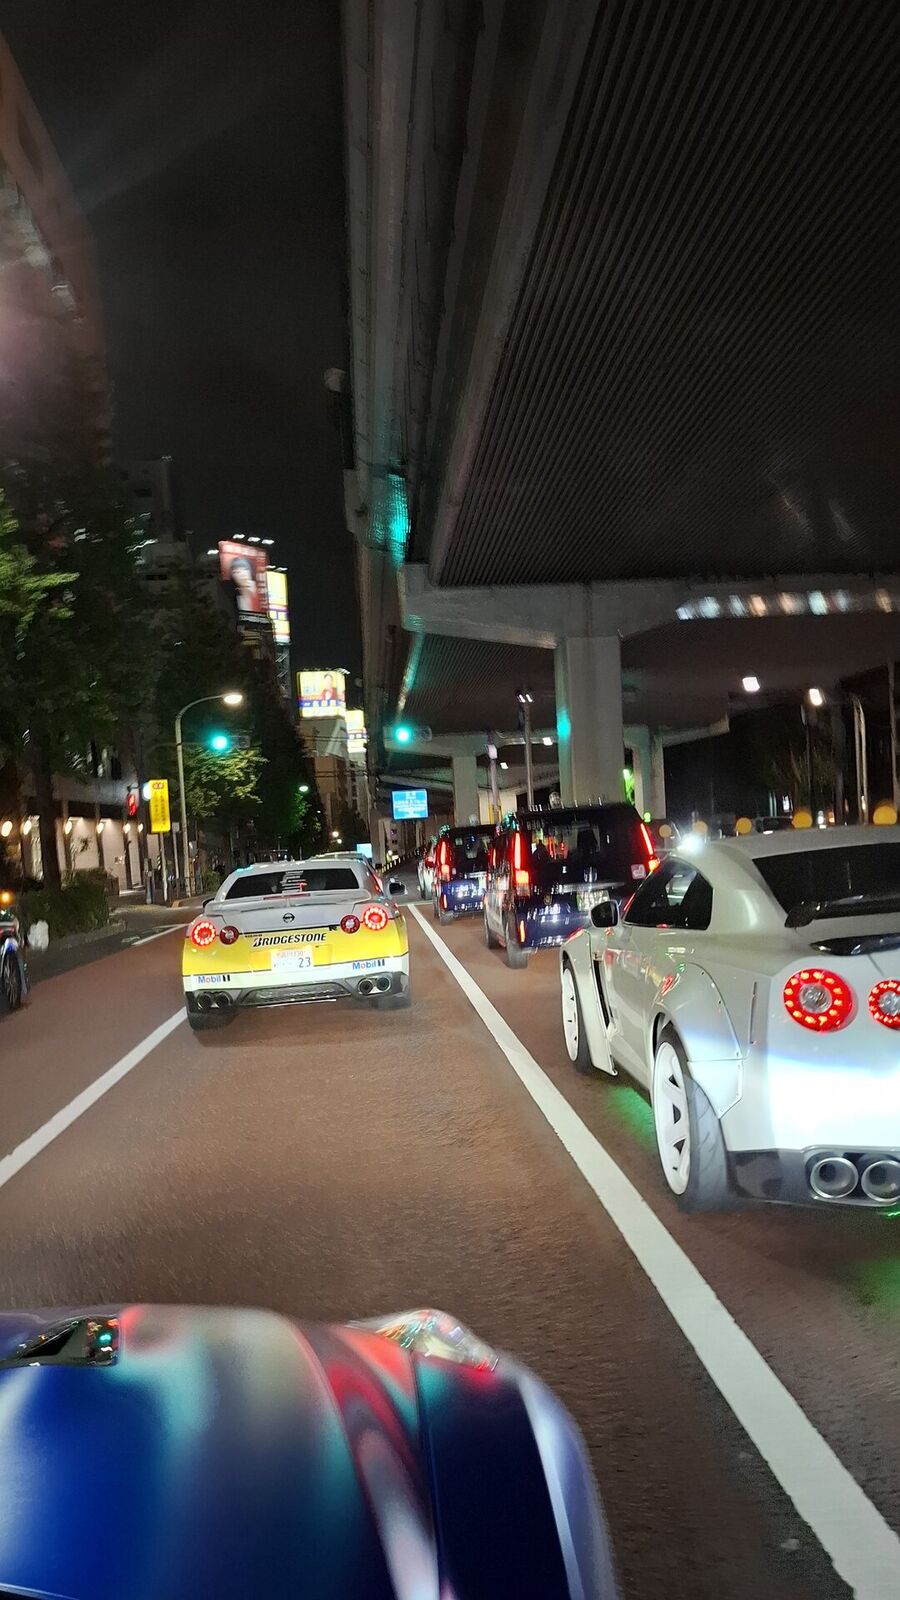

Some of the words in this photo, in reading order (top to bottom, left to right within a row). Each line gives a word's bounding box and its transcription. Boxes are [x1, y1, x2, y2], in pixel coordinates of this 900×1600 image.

[252, 932, 327, 948] BRIDGESTONE
[353, 960, 376, 970] Mobil
[198, 975, 221, 984] Mobil
